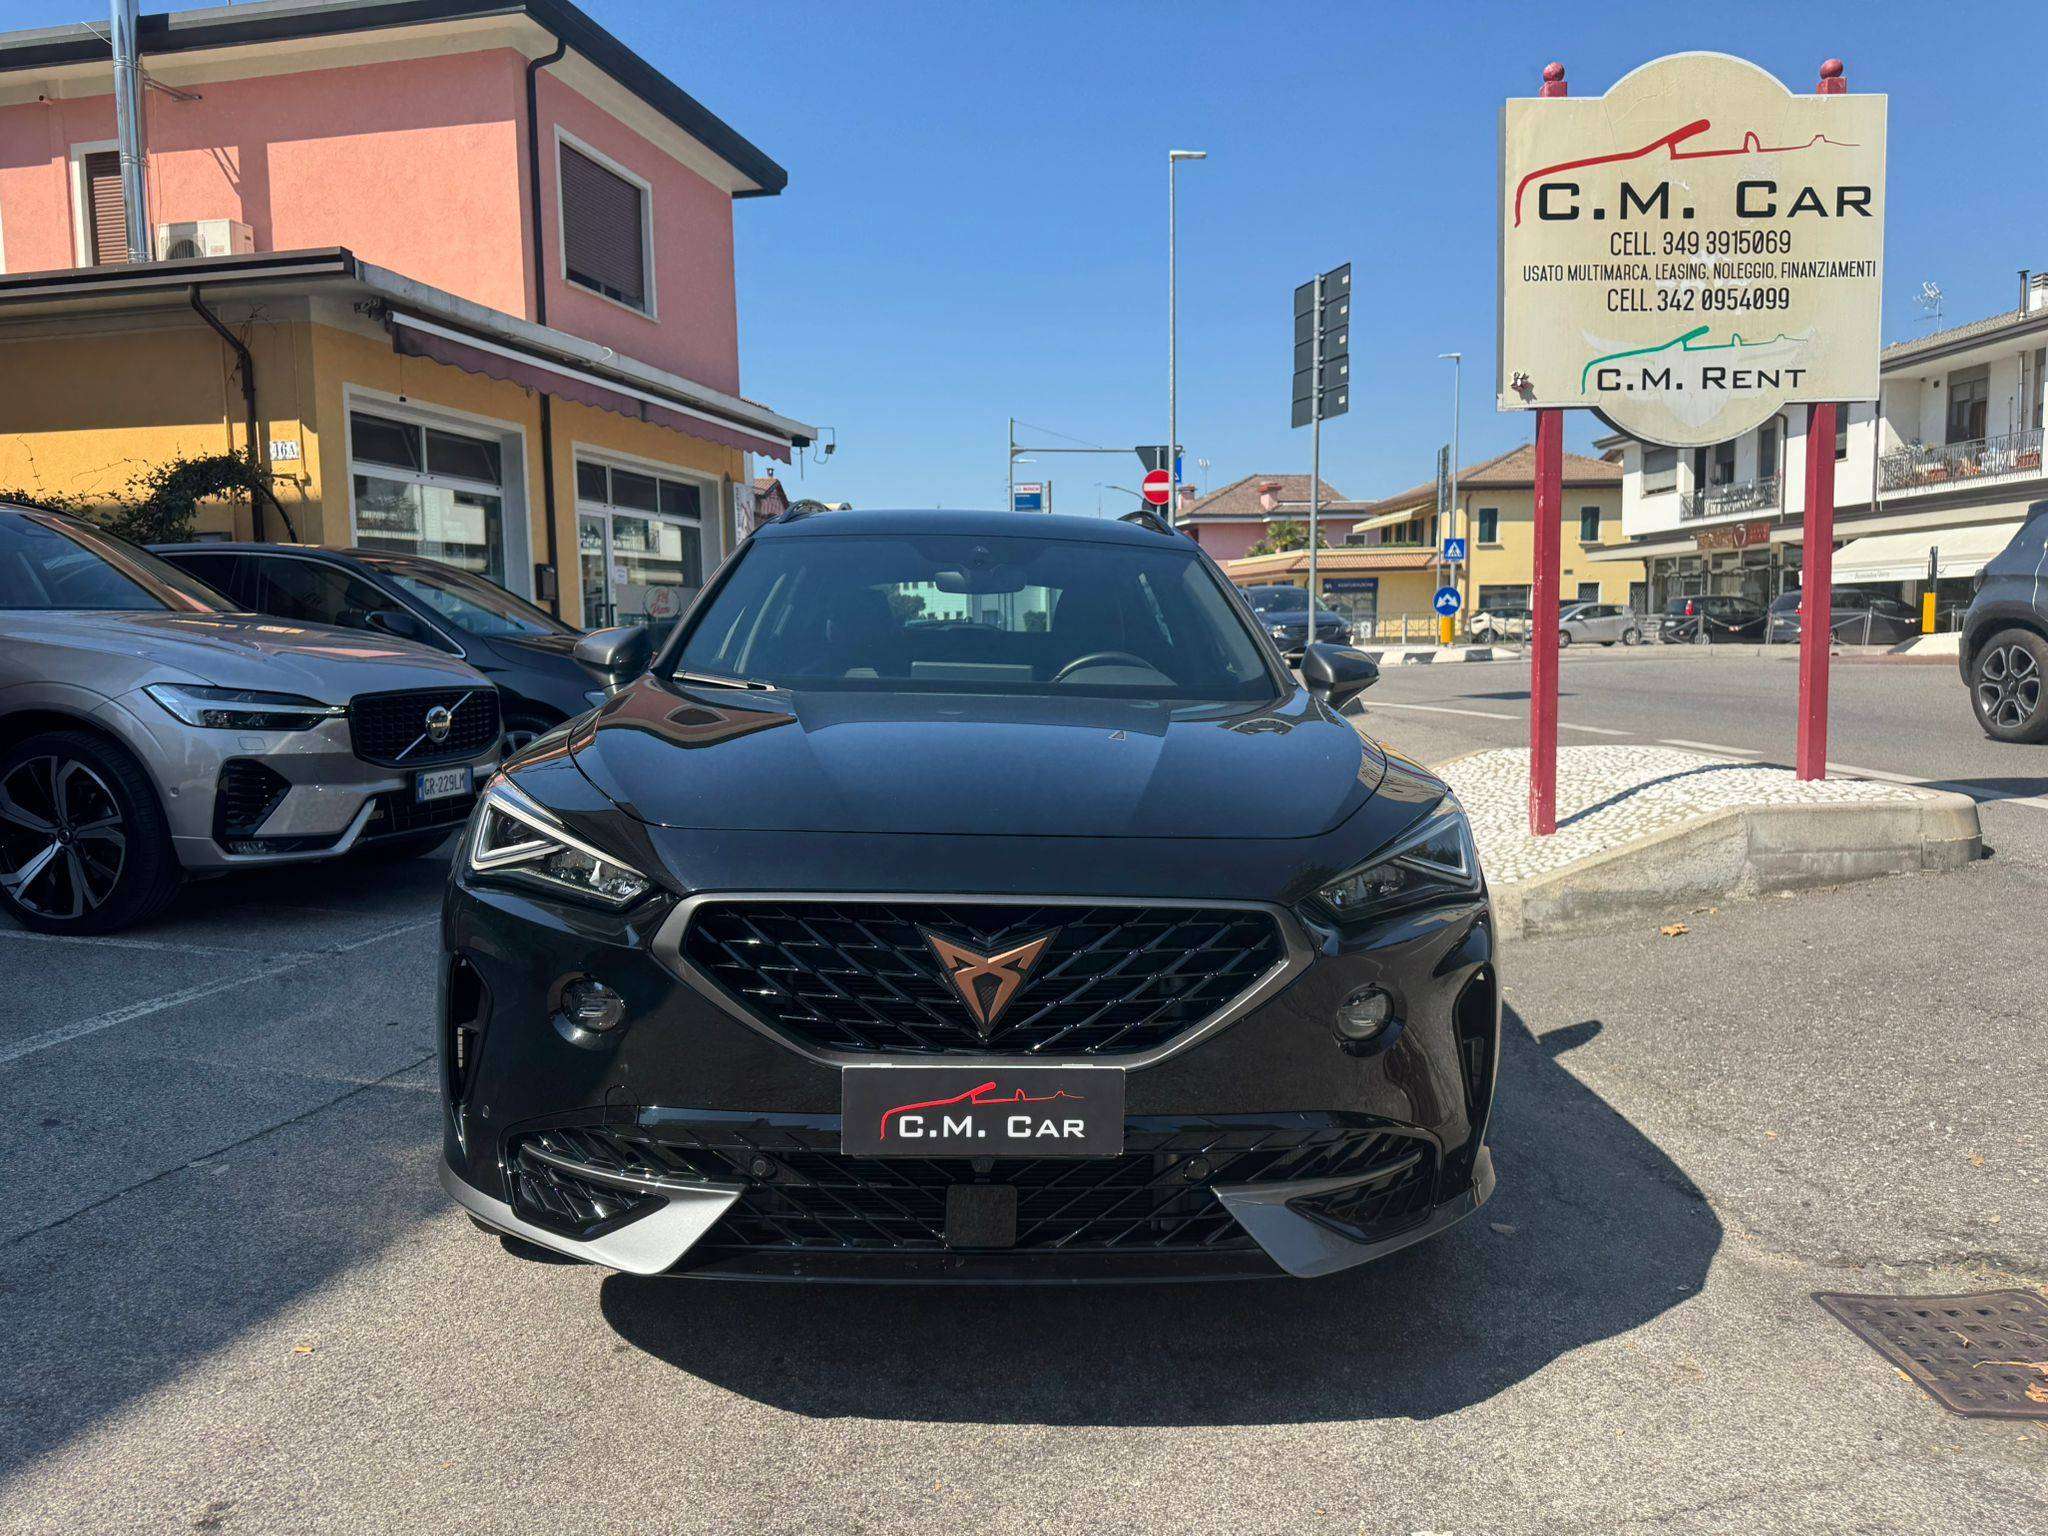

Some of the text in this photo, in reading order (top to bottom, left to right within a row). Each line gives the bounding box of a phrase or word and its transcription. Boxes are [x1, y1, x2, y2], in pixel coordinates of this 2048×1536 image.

[1538, 181, 1695, 220] C.M.
[1610, 229, 1791, 256] CELL. 349 3915069
[1523, 264, 1564, 282] USATO
[1781, 260, 1877, 279] FINANZIAMENTI
[1607, 287, 1790, 312] CELL. 342 0954099
[1597, 367, 1683, 392] C.M.
[899, 1115, 986, 1138] C.M.
